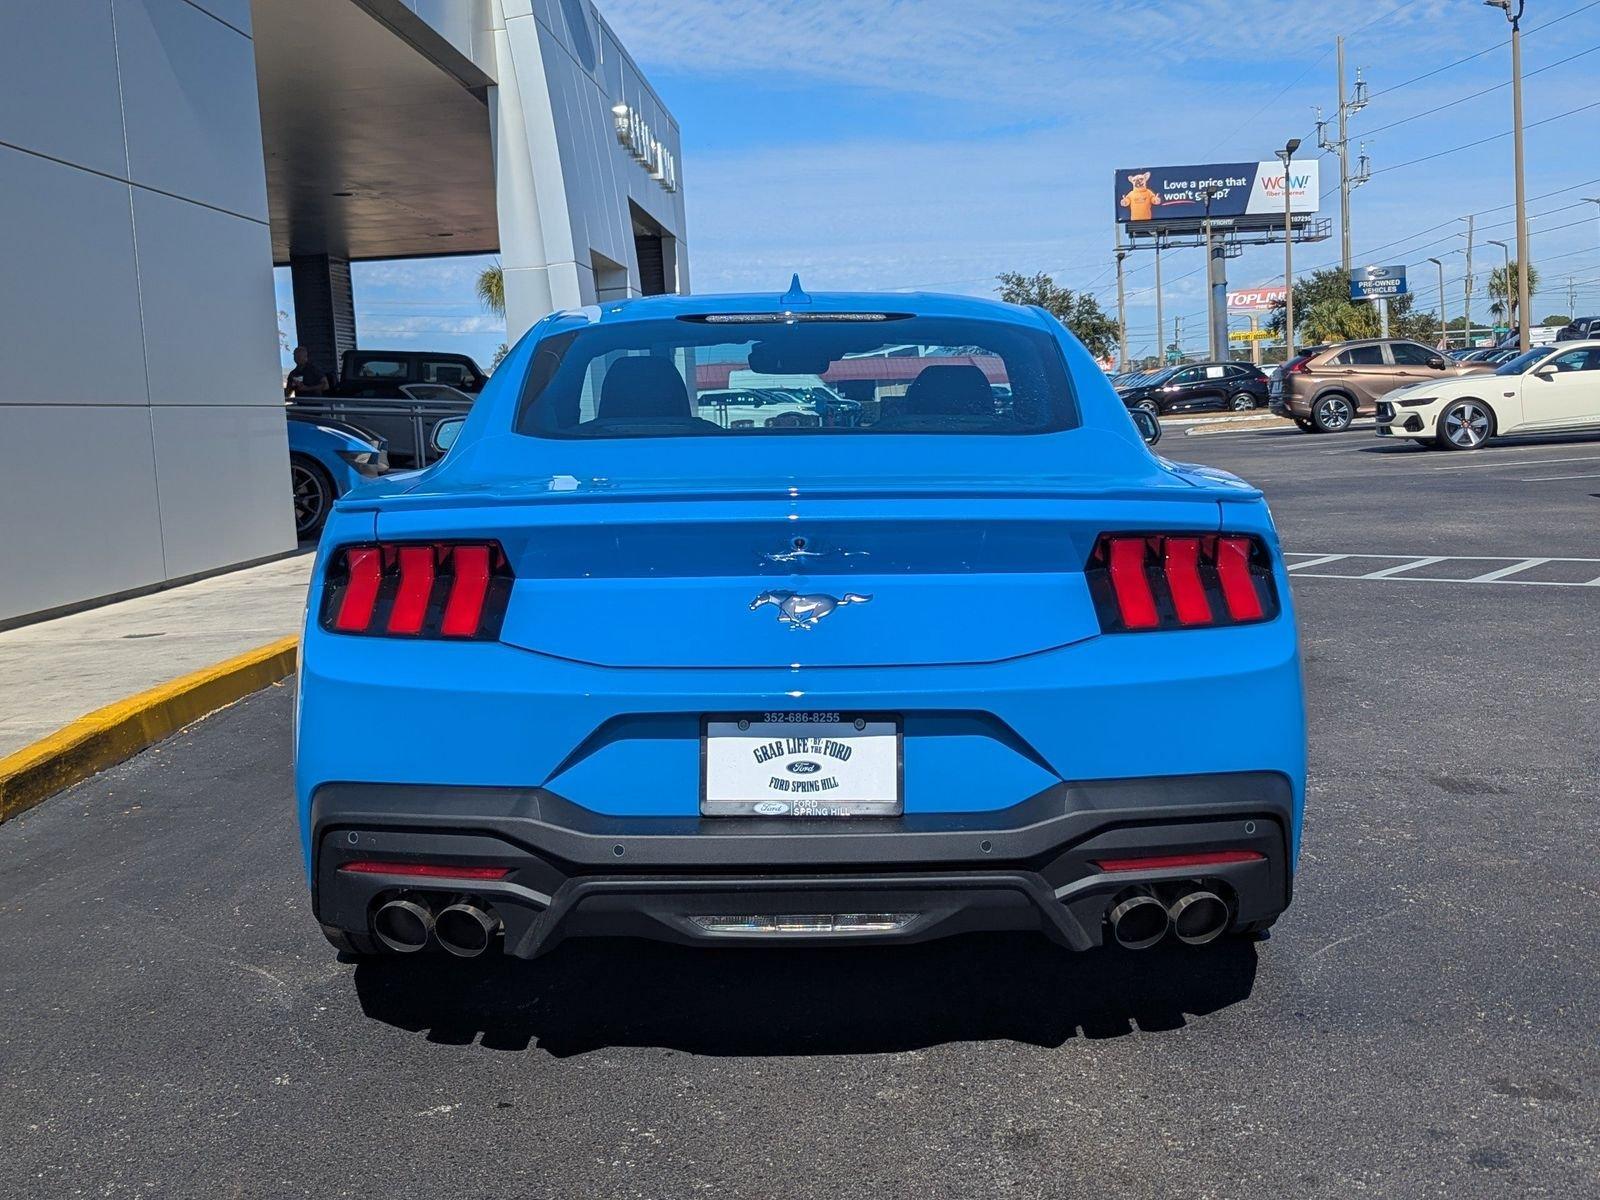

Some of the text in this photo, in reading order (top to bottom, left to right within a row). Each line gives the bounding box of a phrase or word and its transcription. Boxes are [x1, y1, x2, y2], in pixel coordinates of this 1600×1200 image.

[1164, 180, 1187, 190] Love
[1199, 178, 1223, 190] price
[1225, 177, 1246, 187] that
[1164, 190, 1192, 200] won't
[1358, 279, 1400, 288] PRE-OWNED
[1363, 286, 1397, 294] VEHICLES
[764, 713, 840, 723] 352-686-8255
[753, 741, 785, 763] GRAB
[787, 738, 809, 755] LIFE
[811, 745, 823, 754] THE
[823, 740, 853, 762] FORD
[793, 762, 815, 773] Ford
[769, 776, 839, 793] FORD SPRING HILL
[760, 803, 782, 812] Ford
[793, 808, 851, 816] SPRING HILL
